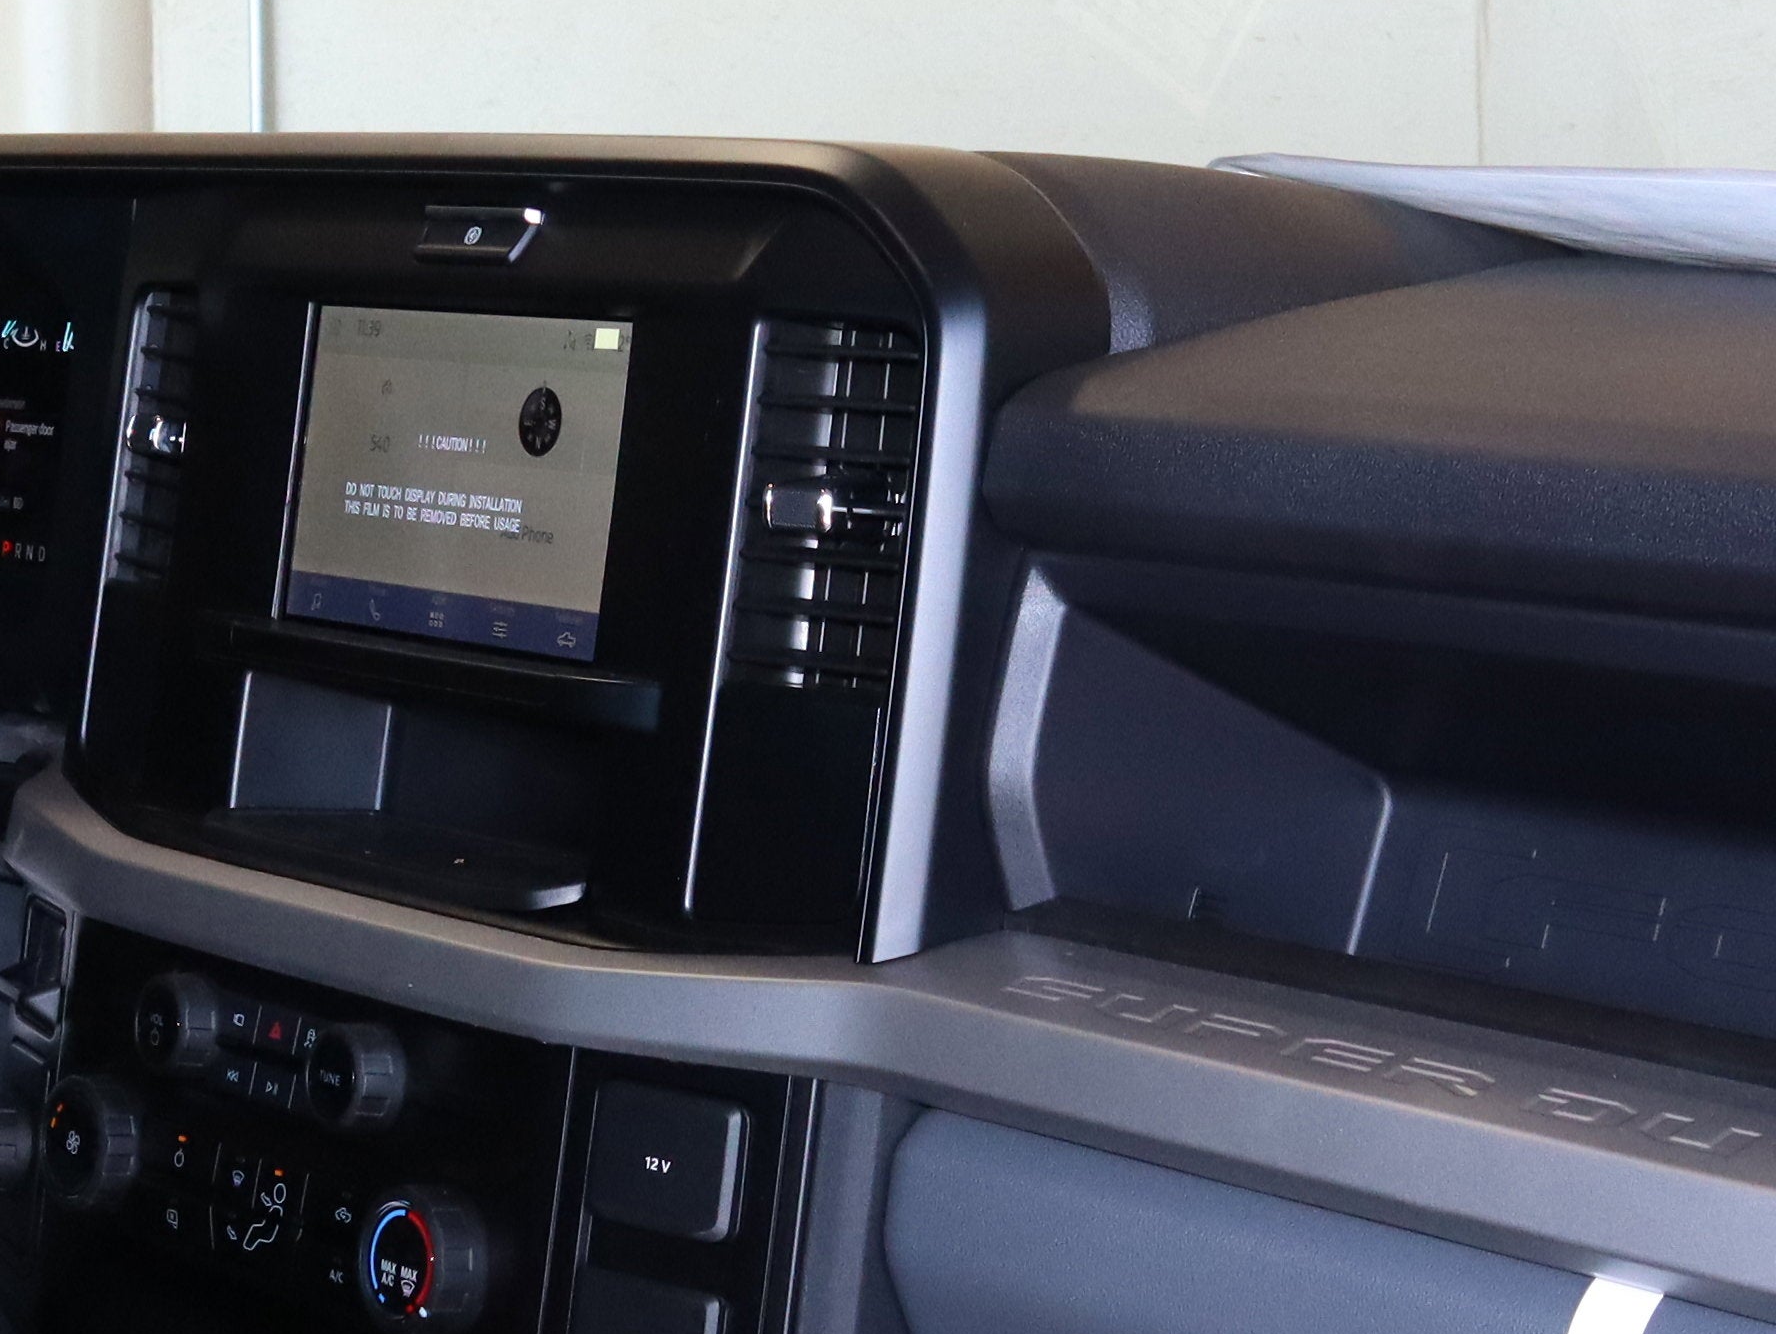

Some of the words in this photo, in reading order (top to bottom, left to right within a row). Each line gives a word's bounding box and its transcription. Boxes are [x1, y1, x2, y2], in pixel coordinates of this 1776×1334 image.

[346, 482, 356, 495] DO
[360, 484, 374, 497] NOT
[378, 485, 402, 500] TOUCH
[405, 488, 435, 503] DISPLAY
[438, 491, 466, 507] DURING
[469, 495, 522, 513] INSTALLATION
[345, 500, 361, 514] THIS
[363, 502, 380, 516] FILM
[383, 504, 390, 518] IS
[394, 505, 403, 519] TO
[407, 507, 417, 521] BE
[421, 508, 456, 525] REMOVED
[460, 513, 490, 529] BEFORE
[494, 517, 520, 532] USAGE
[520, 525, 554, 544] Phone
[1, 541, 12, 557] P
[14, 544, 22, 559] R
[26, 545, 33, 561] N
[38, 547, 46, 562] D
[1001, 975, 1495, 1098] SUPER
[645, 1156, 658, 1171] 12
[662, 1159, 671, 1174] V
[381, 1258, 397, 1275] MAX
[401, 1266, 418, 1281] MAX
[329, 1269, 344, 1284] A/C
[381, 1272, 395, 1287] A/C
